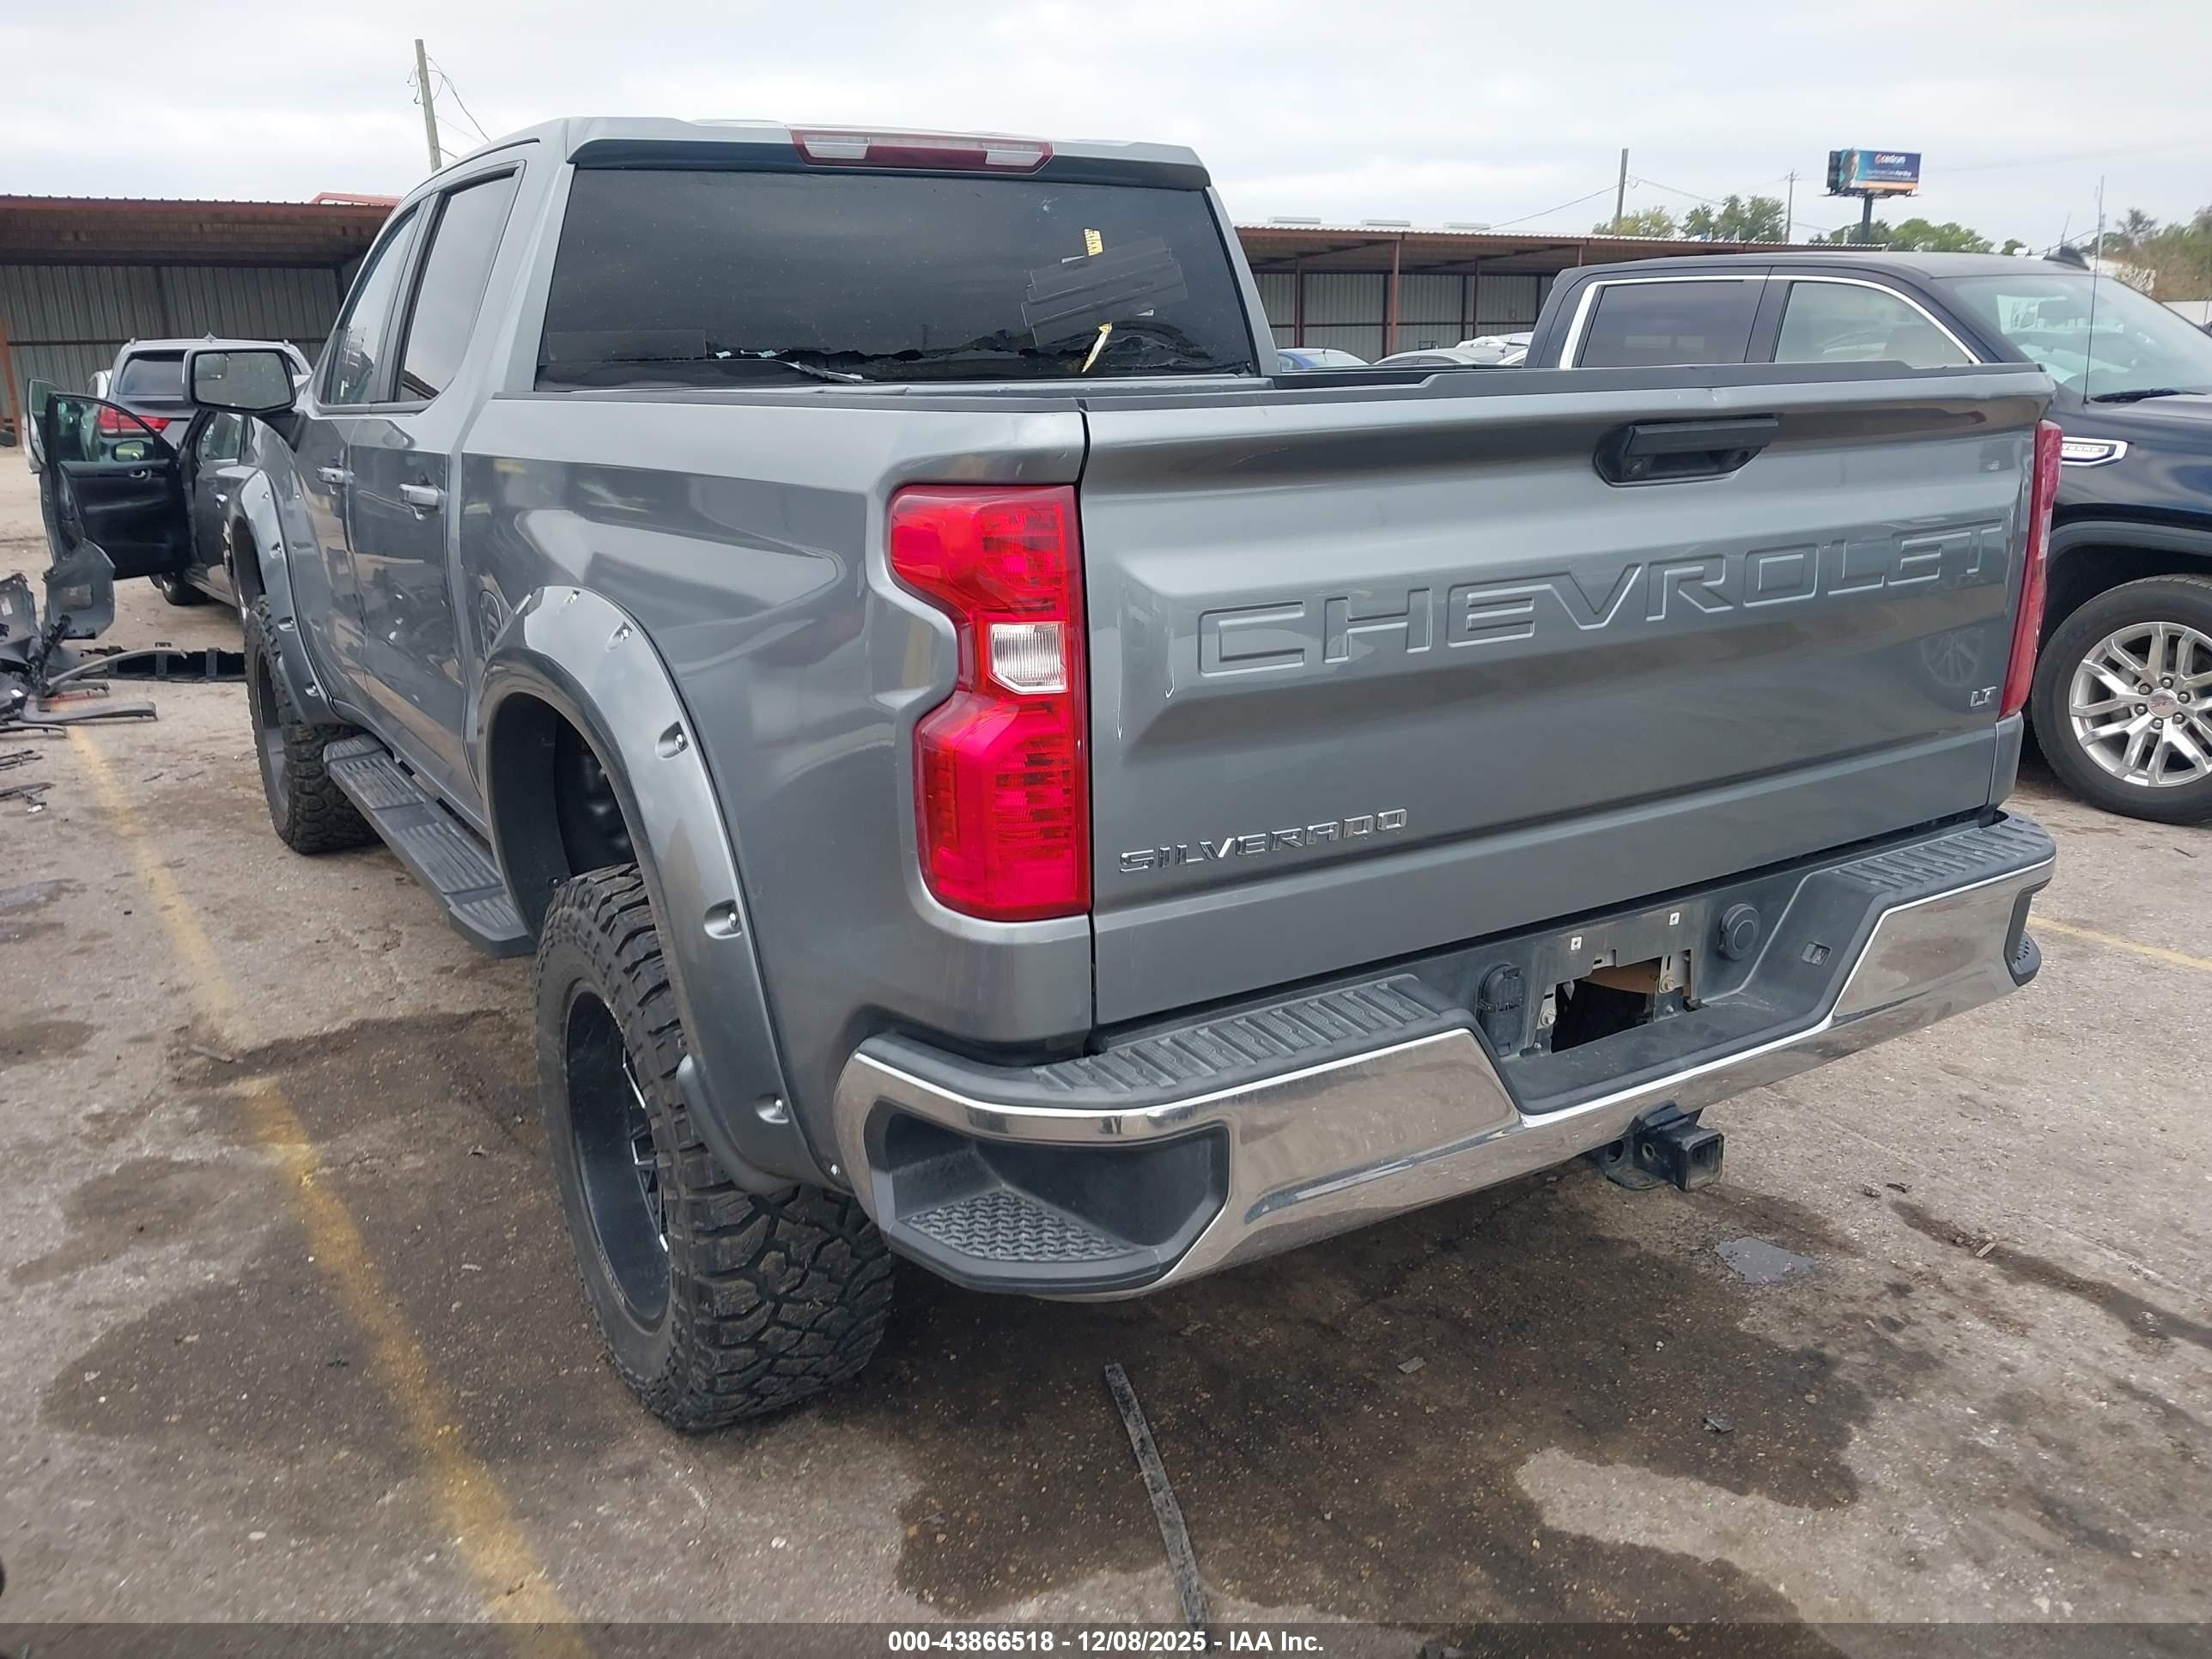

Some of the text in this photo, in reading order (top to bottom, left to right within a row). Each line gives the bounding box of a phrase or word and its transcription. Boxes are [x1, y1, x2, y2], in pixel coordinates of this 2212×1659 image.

[1199, 523, 2002, 678] CHEVROLET
[1970, 686, 1997, 708] LT
[1119, 807, 1408, 873] SILVERADO
